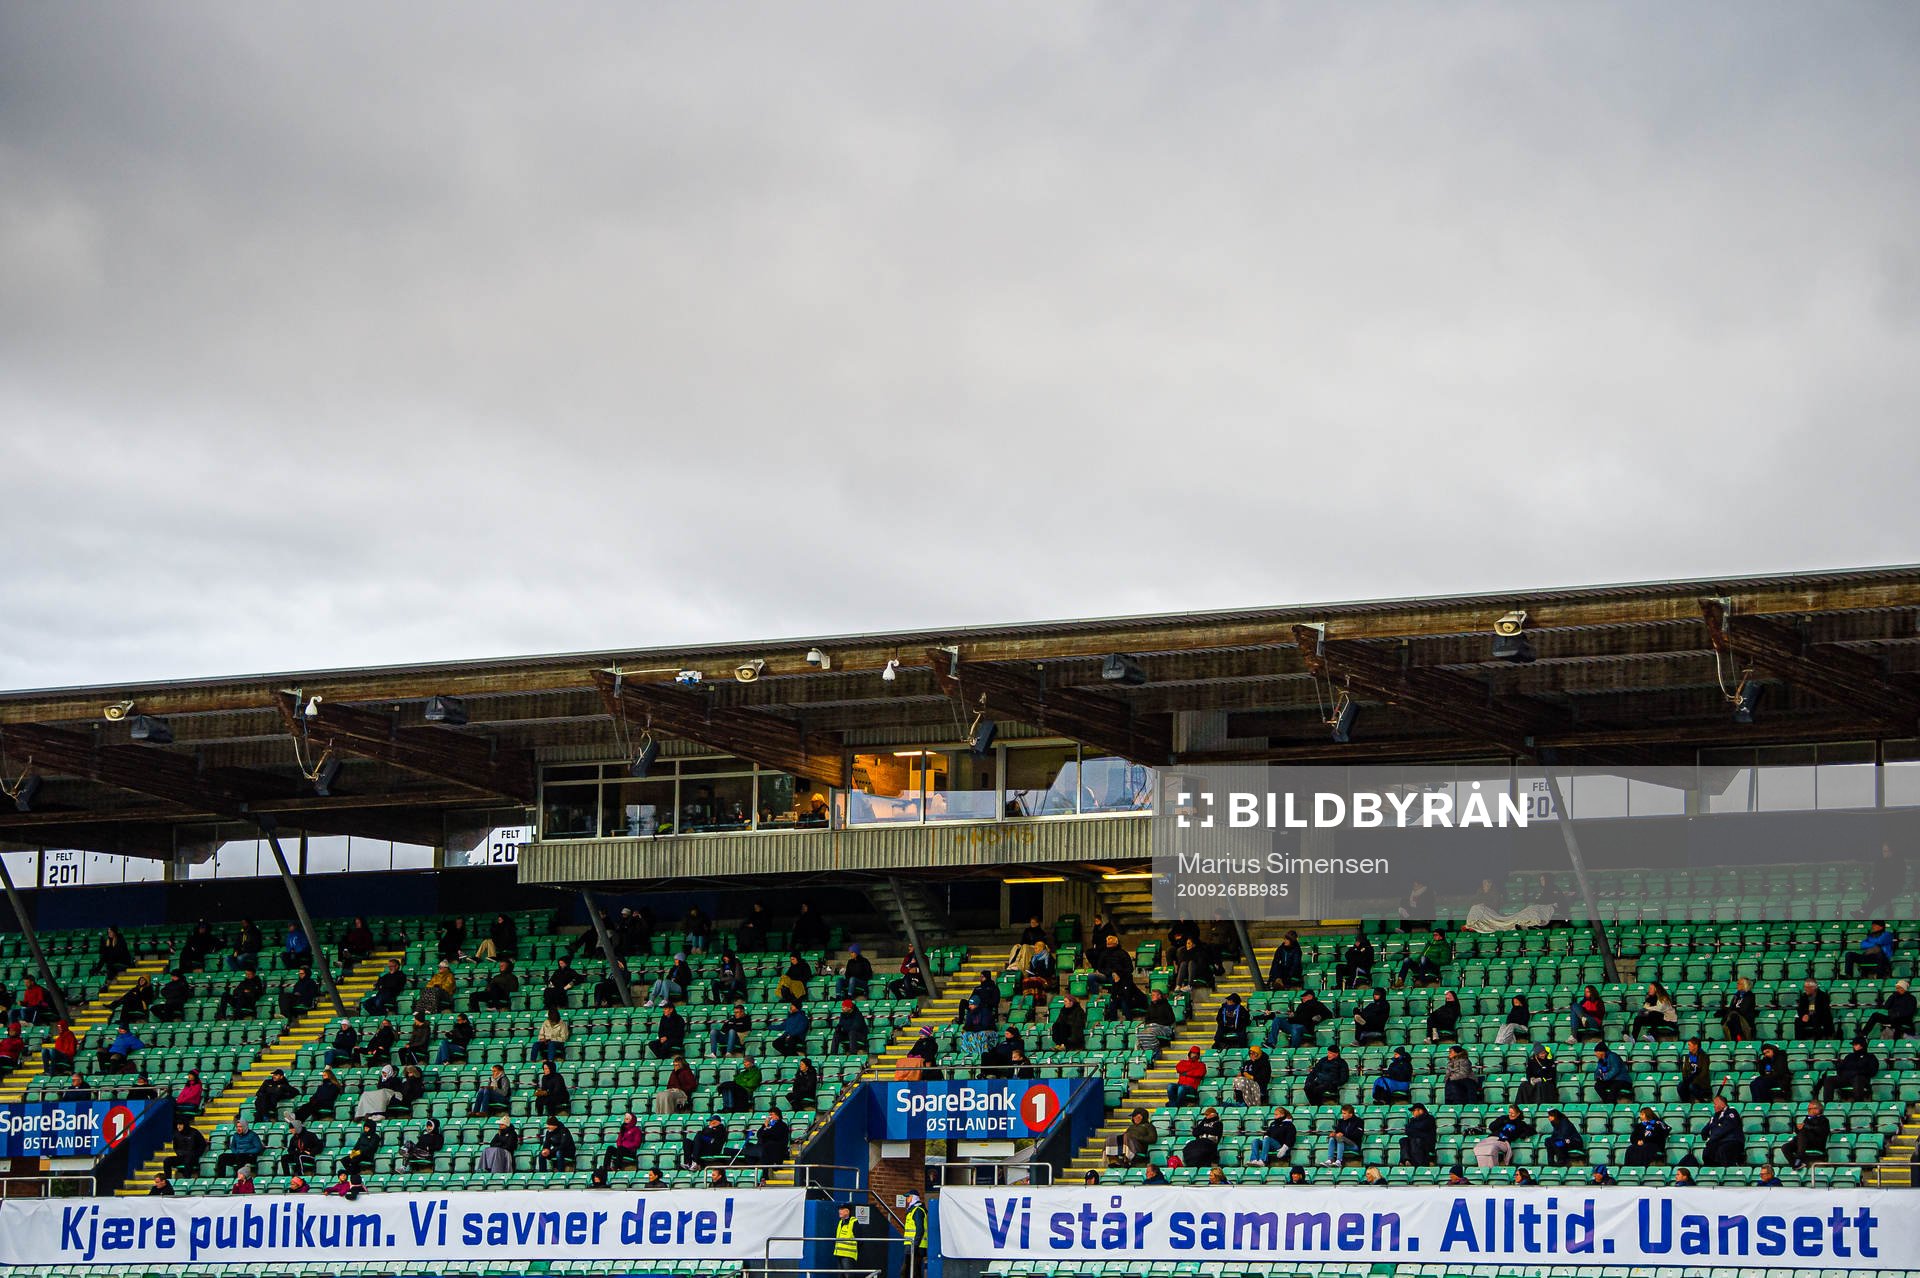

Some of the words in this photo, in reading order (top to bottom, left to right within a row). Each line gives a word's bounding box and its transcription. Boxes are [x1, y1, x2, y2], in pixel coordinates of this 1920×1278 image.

[1532, 782, 1552, 792] FEL
[501, 829, 521, 839] FELT
[55, 852, 73, 861] FELT
[493, 842, 526, 863] 20
[49, 864, 78, 884] 201
[896, 1087, 1016, 1117] SpareBank
[1031, 1093, 1046, 1124] 1
[0, 1108, 100, 1136] SpareBank
[112, 1113, 125, 1141] 1
[926, 1117, 1017, 1132] ØSTLANDET
[23, 1135, 100, 1150] ØSTLANDET
[61, 1204, 176, 1261] Kjære
[190, 1202, 396, 1261] publikum.
[409, 1199, 448, 1247] Vi
[462, 1211, 608, 1246] savner
[620, 1197, 735, 1245] dere!
[984, 1196, 1032, 1250] Vi
[1048, 1195, 1153, 1250] står
[1169, 1211, 1419, 1252] sammen.
[1440, 1197, 1615, 1254] Alltid.
[1638, 1198, 1878, 1257] Uansett
